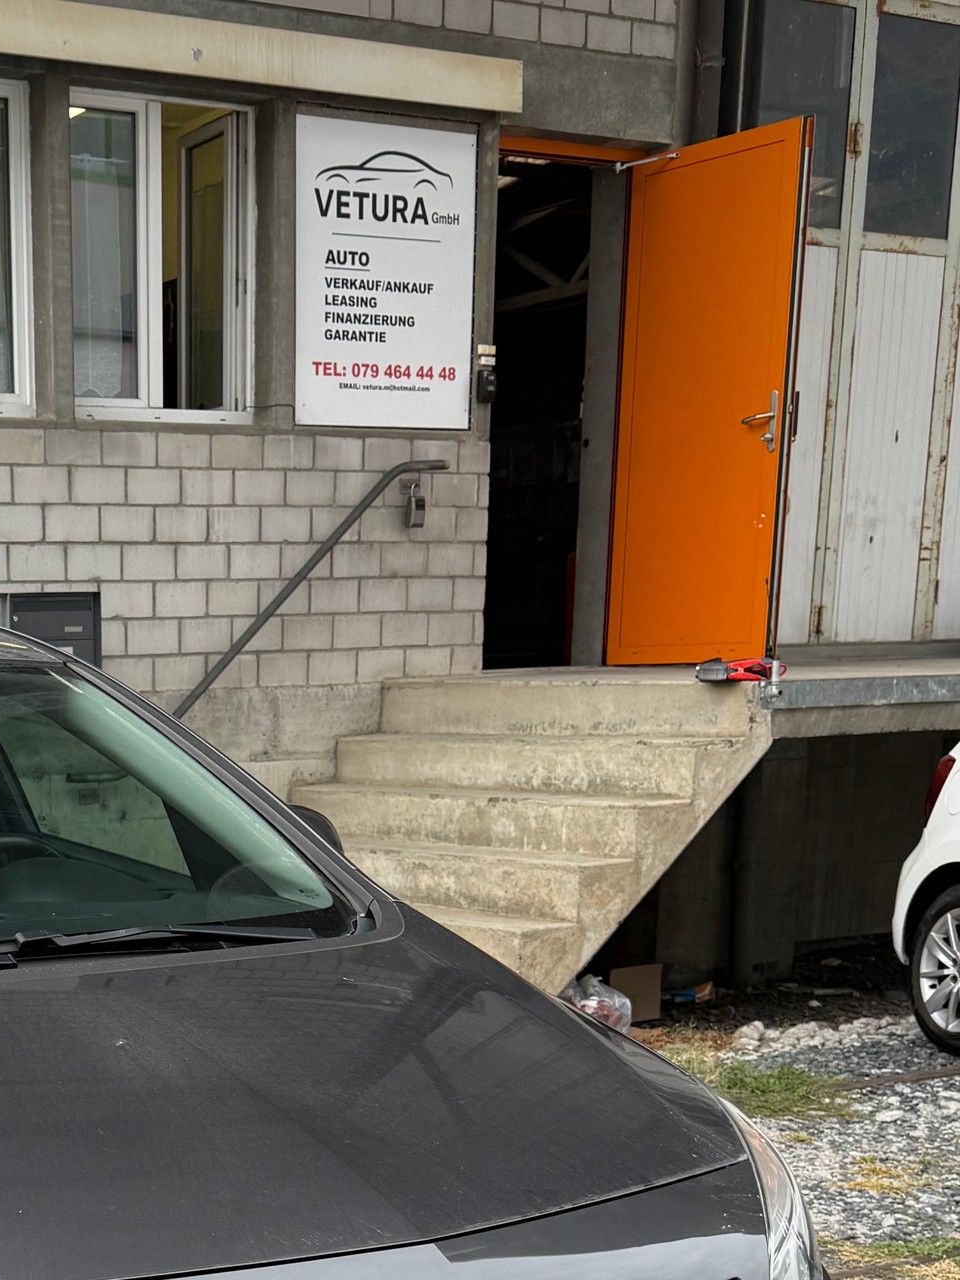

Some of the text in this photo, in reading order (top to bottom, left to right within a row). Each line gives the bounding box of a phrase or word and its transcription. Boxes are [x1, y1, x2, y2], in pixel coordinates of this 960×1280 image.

[314, 188, 460, 226] VETURA GmbH
[325, 249, 370, 267] AUTO
[325, 277, 434, 295] VERKAUF/ANKAUF
[325, 294, 377, 309] LEASING
[325, 312, 415, 328] FINANZIERUNG
[324, 329, 386, 344] GARANTIE
[312, 361, 456, 382] TEL: 079 464 44 48
[339, 382, 361, 390] EMAIL:
